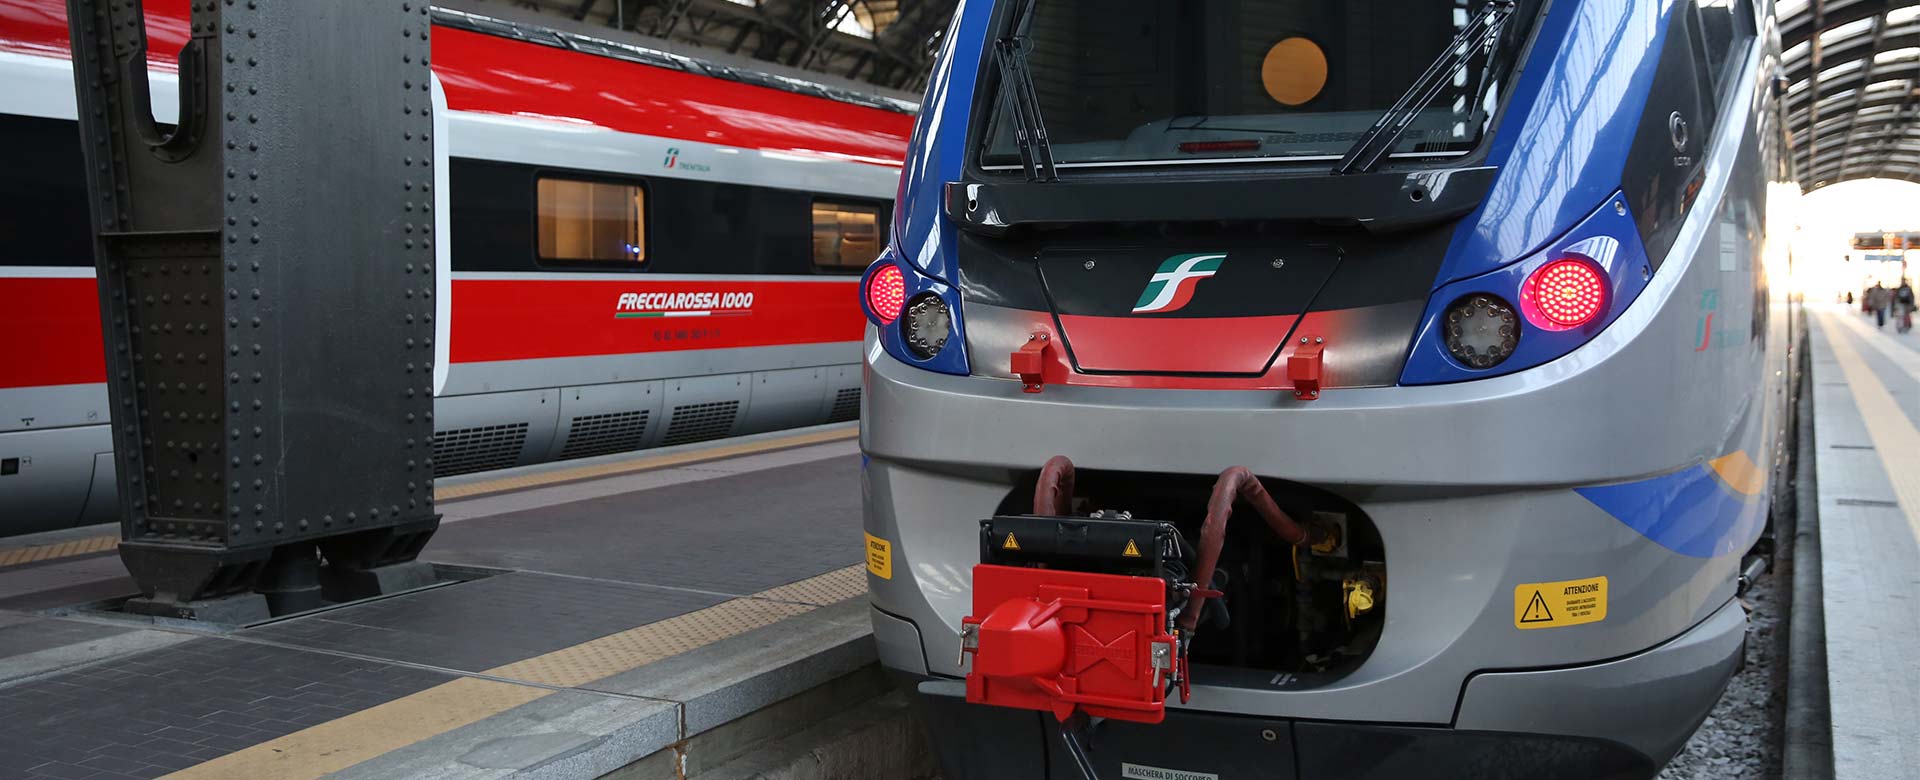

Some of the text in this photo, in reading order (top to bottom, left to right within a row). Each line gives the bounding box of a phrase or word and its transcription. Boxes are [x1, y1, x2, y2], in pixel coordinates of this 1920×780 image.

[617, 293, 753, 310] FRECCIAROSSA 1000
[1564, 583, 1599, 595] ATTENZIONE
[1128, 767, 1164, 779] MASCHERA
[1165, 772, 1173, 780] DI
